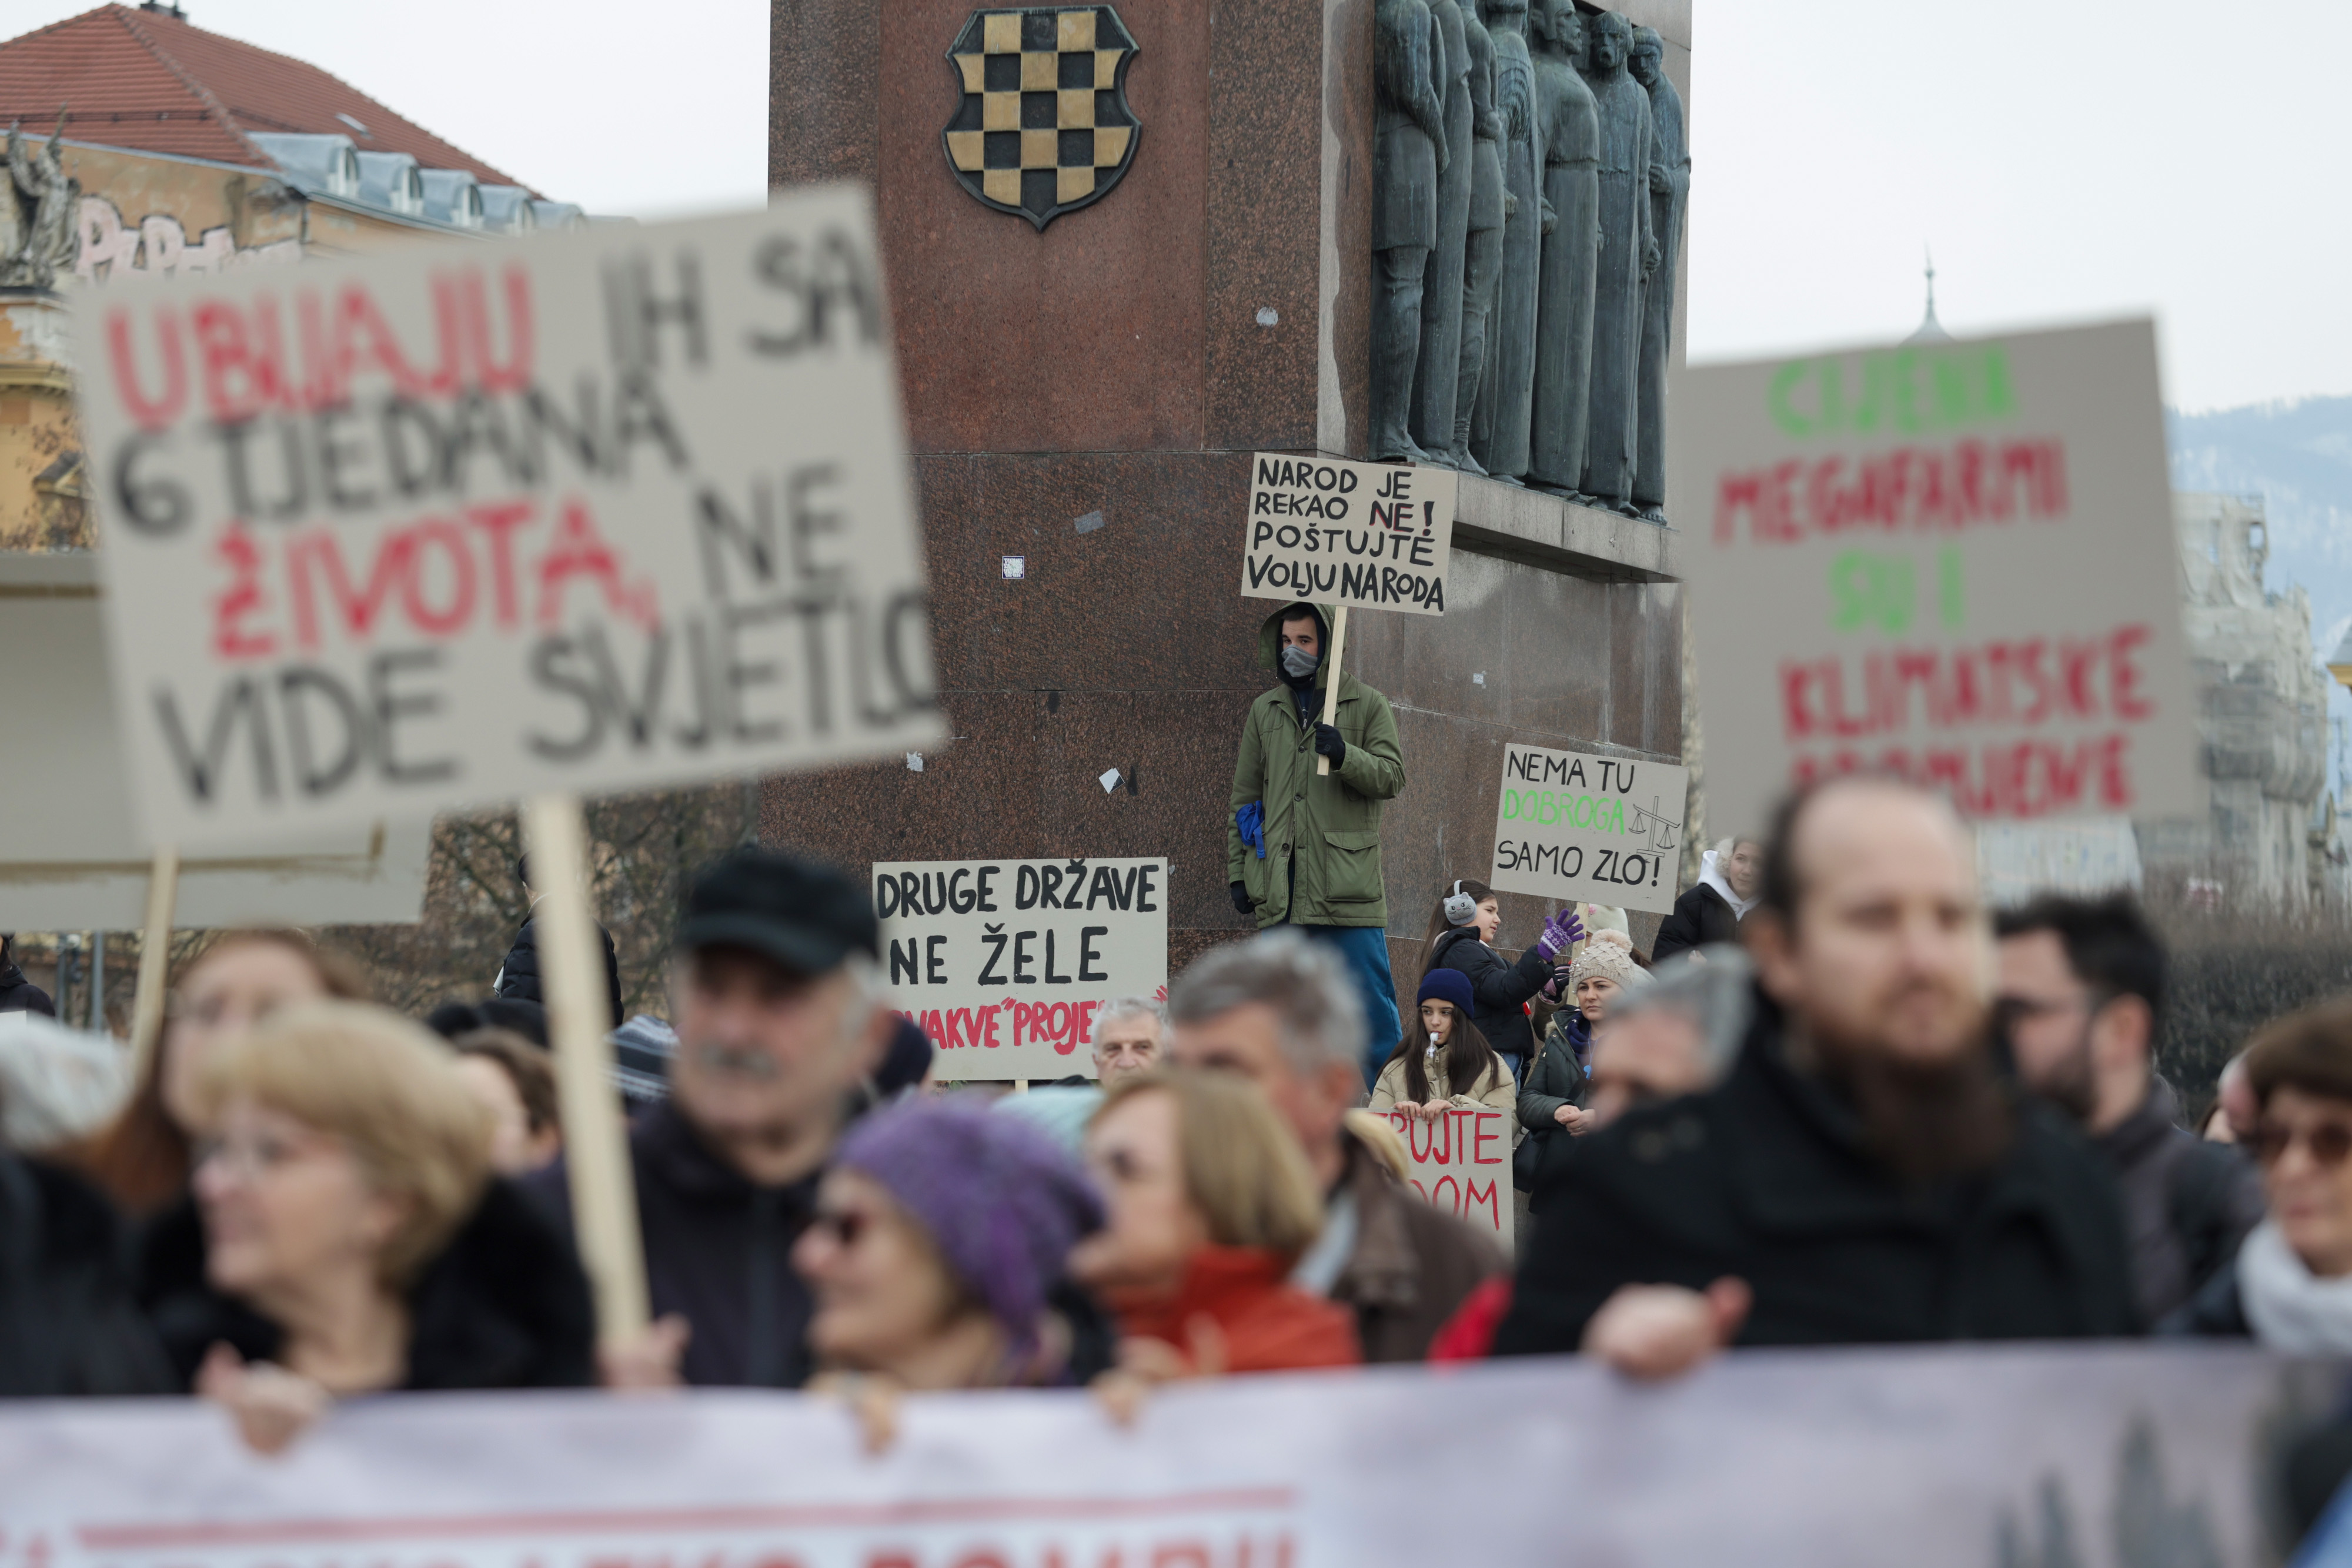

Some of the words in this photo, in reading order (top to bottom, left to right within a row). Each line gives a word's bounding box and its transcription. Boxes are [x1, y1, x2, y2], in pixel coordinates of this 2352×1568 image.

[108, 266, 535, 427] UBIJAJU
[599, 242, 710, 375] IH
[742, 226, 884, 362] SA
[111, 429, 194, 539] 6
[205, 375, 690, 520] TJEDANA
[1258, 458, 1358, 493] NAROD
[1377, 470, 1412, 499] JE
[691, 459, 850, 597] NE
[1255, 492, 1348, 520] REKAO
[1253, 521, 1435, 566] POŠTUJTE
[1248, 554, 1336, 597] VOLJU
[1341, 562, 1444, 612] NARODA
[152, 647, 467, 808] VIDE
[527, 593, 938, 760] SVJETLO
[1779, 622, 2155, 744] KLIMATSKE
[1508, 750, 1586, 787] NEMA
[1597, 760, 1635, 794] TU
[1503, 789, 1625, 835] DOBROGA
[877, 866, 1001, 918] DRUGE
[1015, 858, 1159, 912] DRŽAVE
[1497, 840, 1583, 877] SAMO
[1592, 849, 1660, 887] ZLO!
[890, 935, 948, 985] NE
[978, 922, 1108, 986] ŽELE
[890, 1004, 1000, 1049] AKVE
[1409, 1175, 1499, 1231] OM
